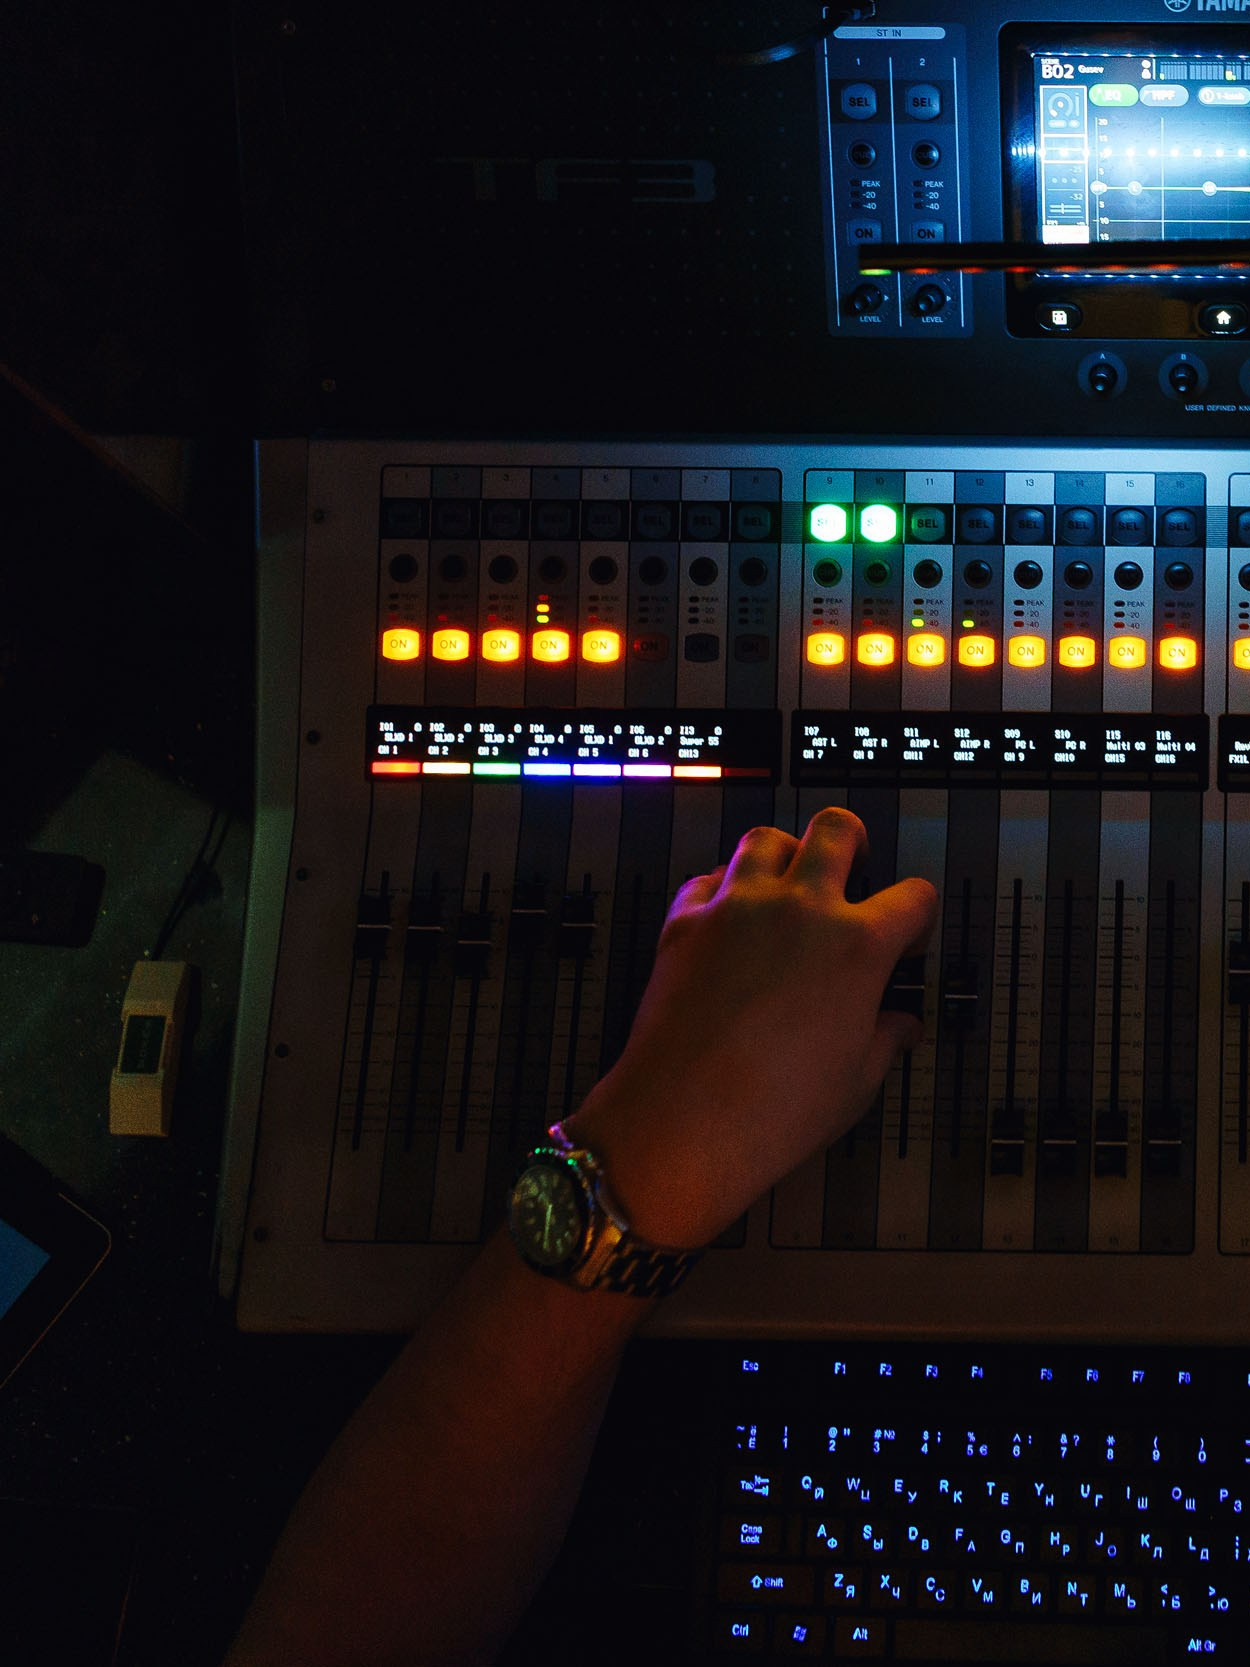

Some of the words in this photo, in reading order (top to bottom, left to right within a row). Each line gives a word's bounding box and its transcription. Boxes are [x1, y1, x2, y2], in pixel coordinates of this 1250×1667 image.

[919, 58, 925, 66] 2
[1042, 65, 1074, 79] B02
[849, 98, 870, 106] SEL
[913, 98, 932, 107] SEL
[855, 228, 873, 238] ON
[917, 229, 935, 239] ON
[925, 478, 934, 486] 11
[1025, 479, 1035, 487] 13
[1125, 480, 1135, 488] 15
[917, 519, 938, 529] SEL
[968, 519, 989, 529] SEL
[1018, 520, 1040, 530] SEL
[1118, 522, 1140, 531] SEL
[390, 639, 407, 649] ON
[540, 640, 557, 650] ON
[815, 643, 833, 654] ON
[916, 644, 933, 655] ON
[1017, 646, 1035, 657] ON
[1118, 646, 1135, 657] ON
[831, 738, 837, 747] L
[934, 739, 939, 748] L
[1030, 740, 1035, 749] L
[818, 750, 823, 759] 7
[1018, 752, 1024, 761] 9
[742, 1360, 759, 1371] Esc
[834, 1362, 846, 1374] F1
[880, 1363, 892, 1376] F2
[926, 1365, 938, 1378] F3
[971, 1366, 983, 1378] F4
[1041, 1368, 1052, 1380] F5
[1087, 1369, 1098, 1382] F6
[1132, 1371, 1144, 1382] F7
